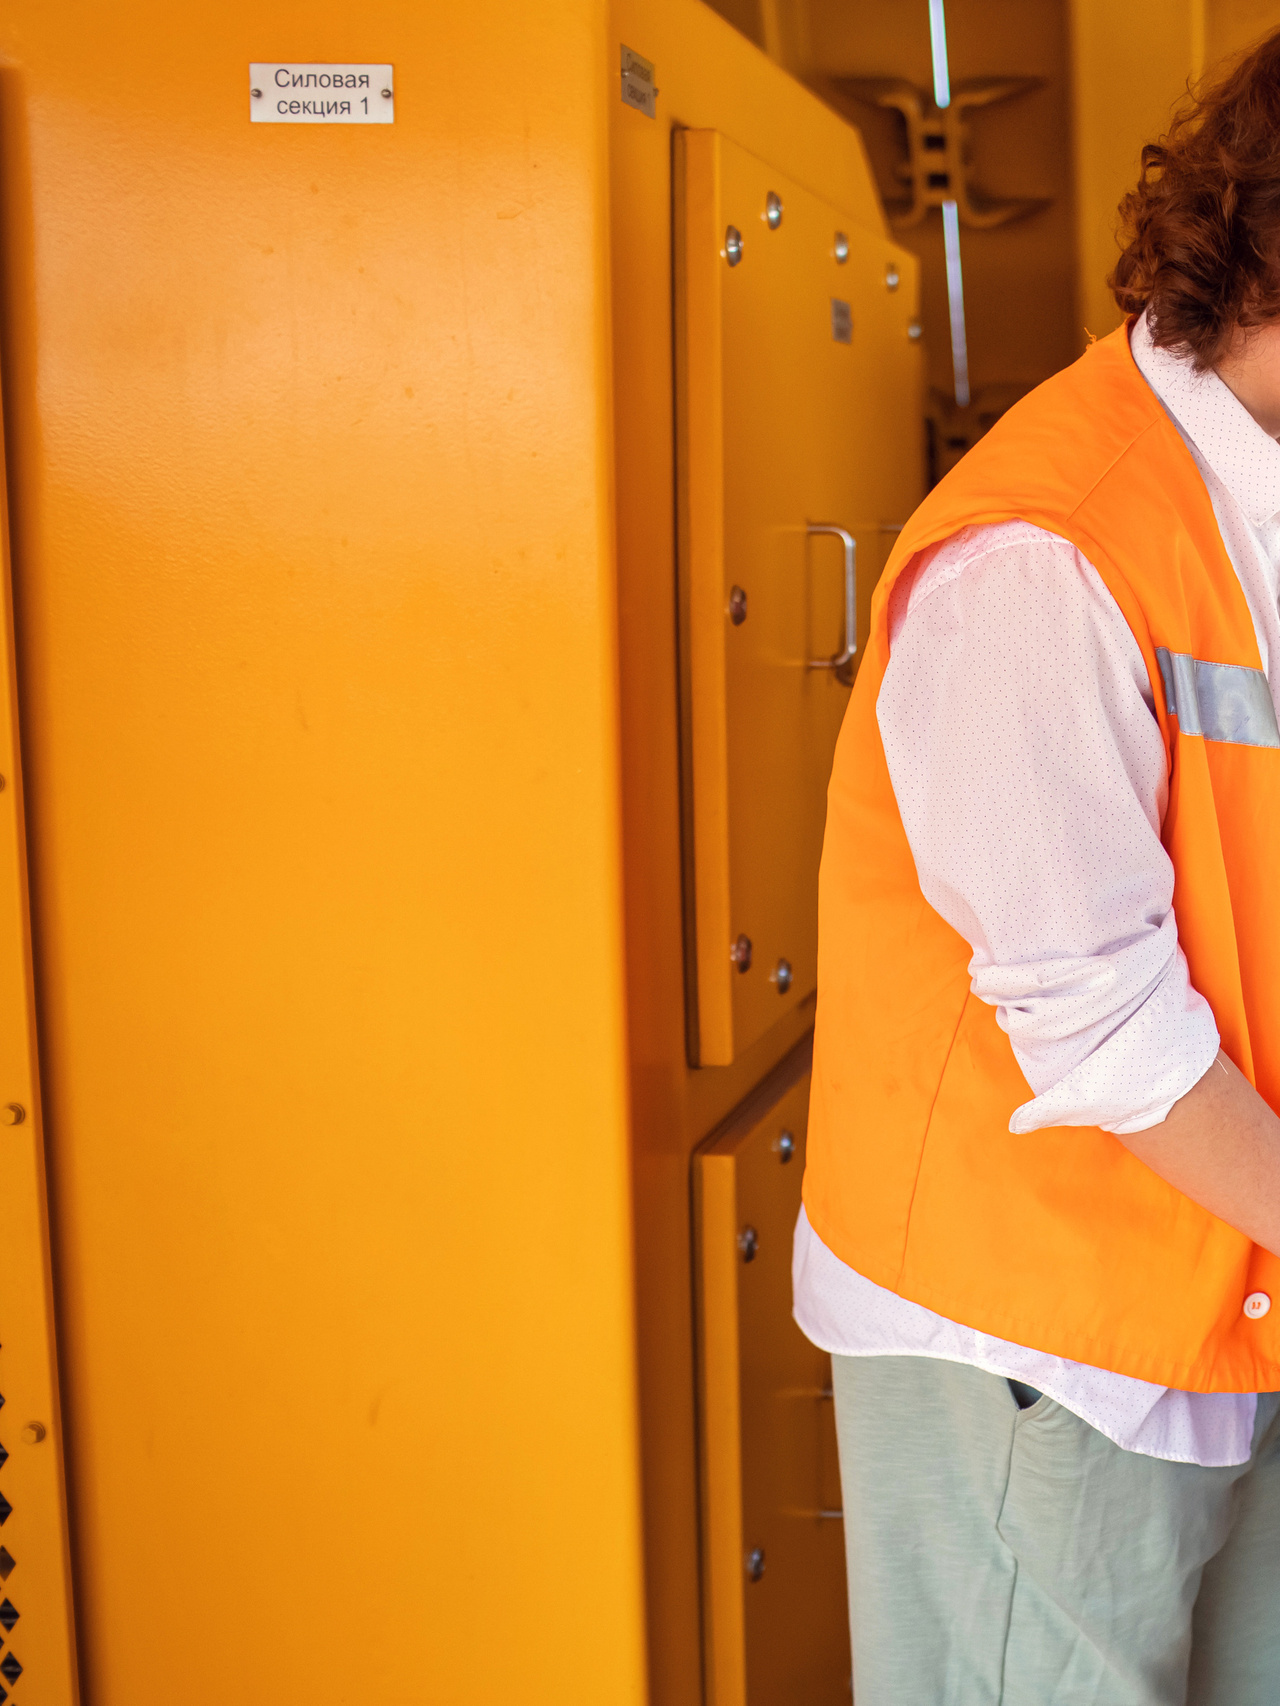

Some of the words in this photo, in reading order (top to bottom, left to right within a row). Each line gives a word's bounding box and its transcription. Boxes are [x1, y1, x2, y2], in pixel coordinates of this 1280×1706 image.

[274, 68, 370, 88] Силовая
[276, 100, 351, 118] секция
[360, 97, 368, 115] 1
